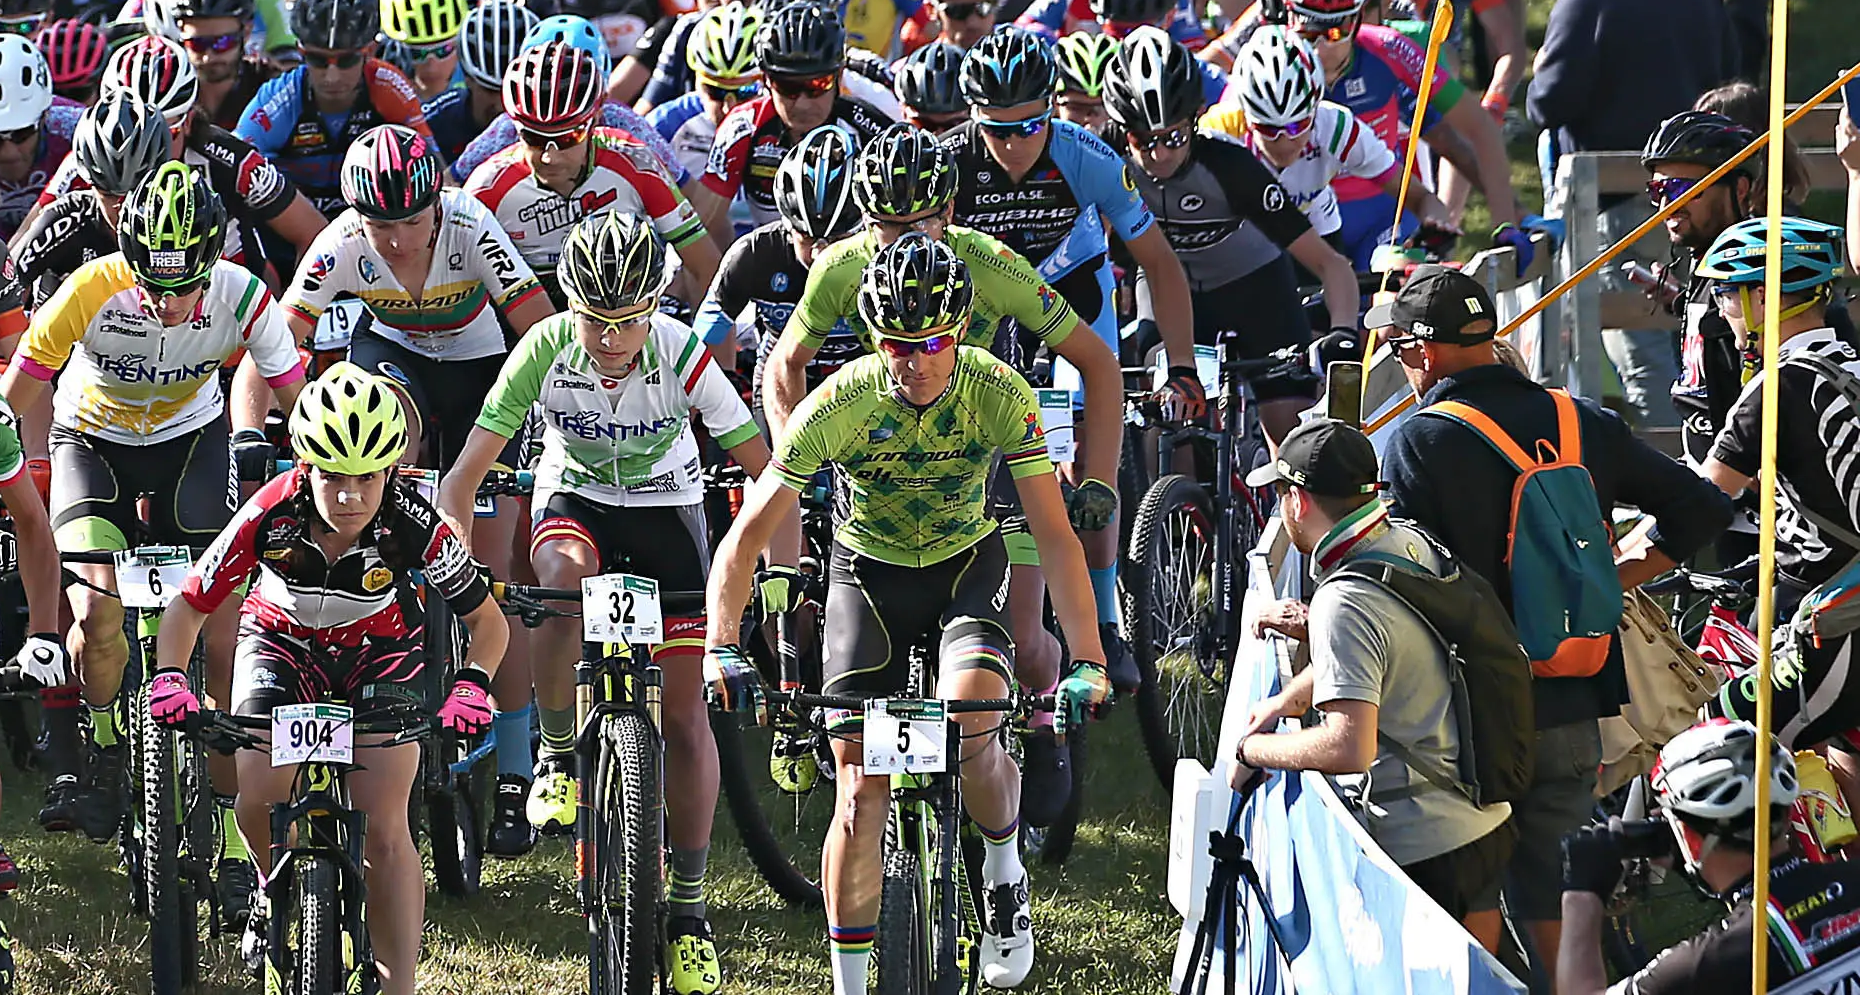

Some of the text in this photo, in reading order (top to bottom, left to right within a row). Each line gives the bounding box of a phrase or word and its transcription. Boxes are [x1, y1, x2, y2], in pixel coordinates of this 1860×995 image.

[18, 208, 92, 273] RUDY
[150, 257, 179, 267] FREE
[476, 229, 521, 289] VIFRA
[966, 242, 1036, 286] Buonristoro
[324, 306, 350, 333] 79
[92, 351, 222, 385] TRENTINO
[961, 361, 1030, 408] Buonristoro
[148, 567, 163, 597] 6
[607, 591, 636, 625] 32
[289, 719, 334, 749] 904
[896, 721, 911, 755] 5
